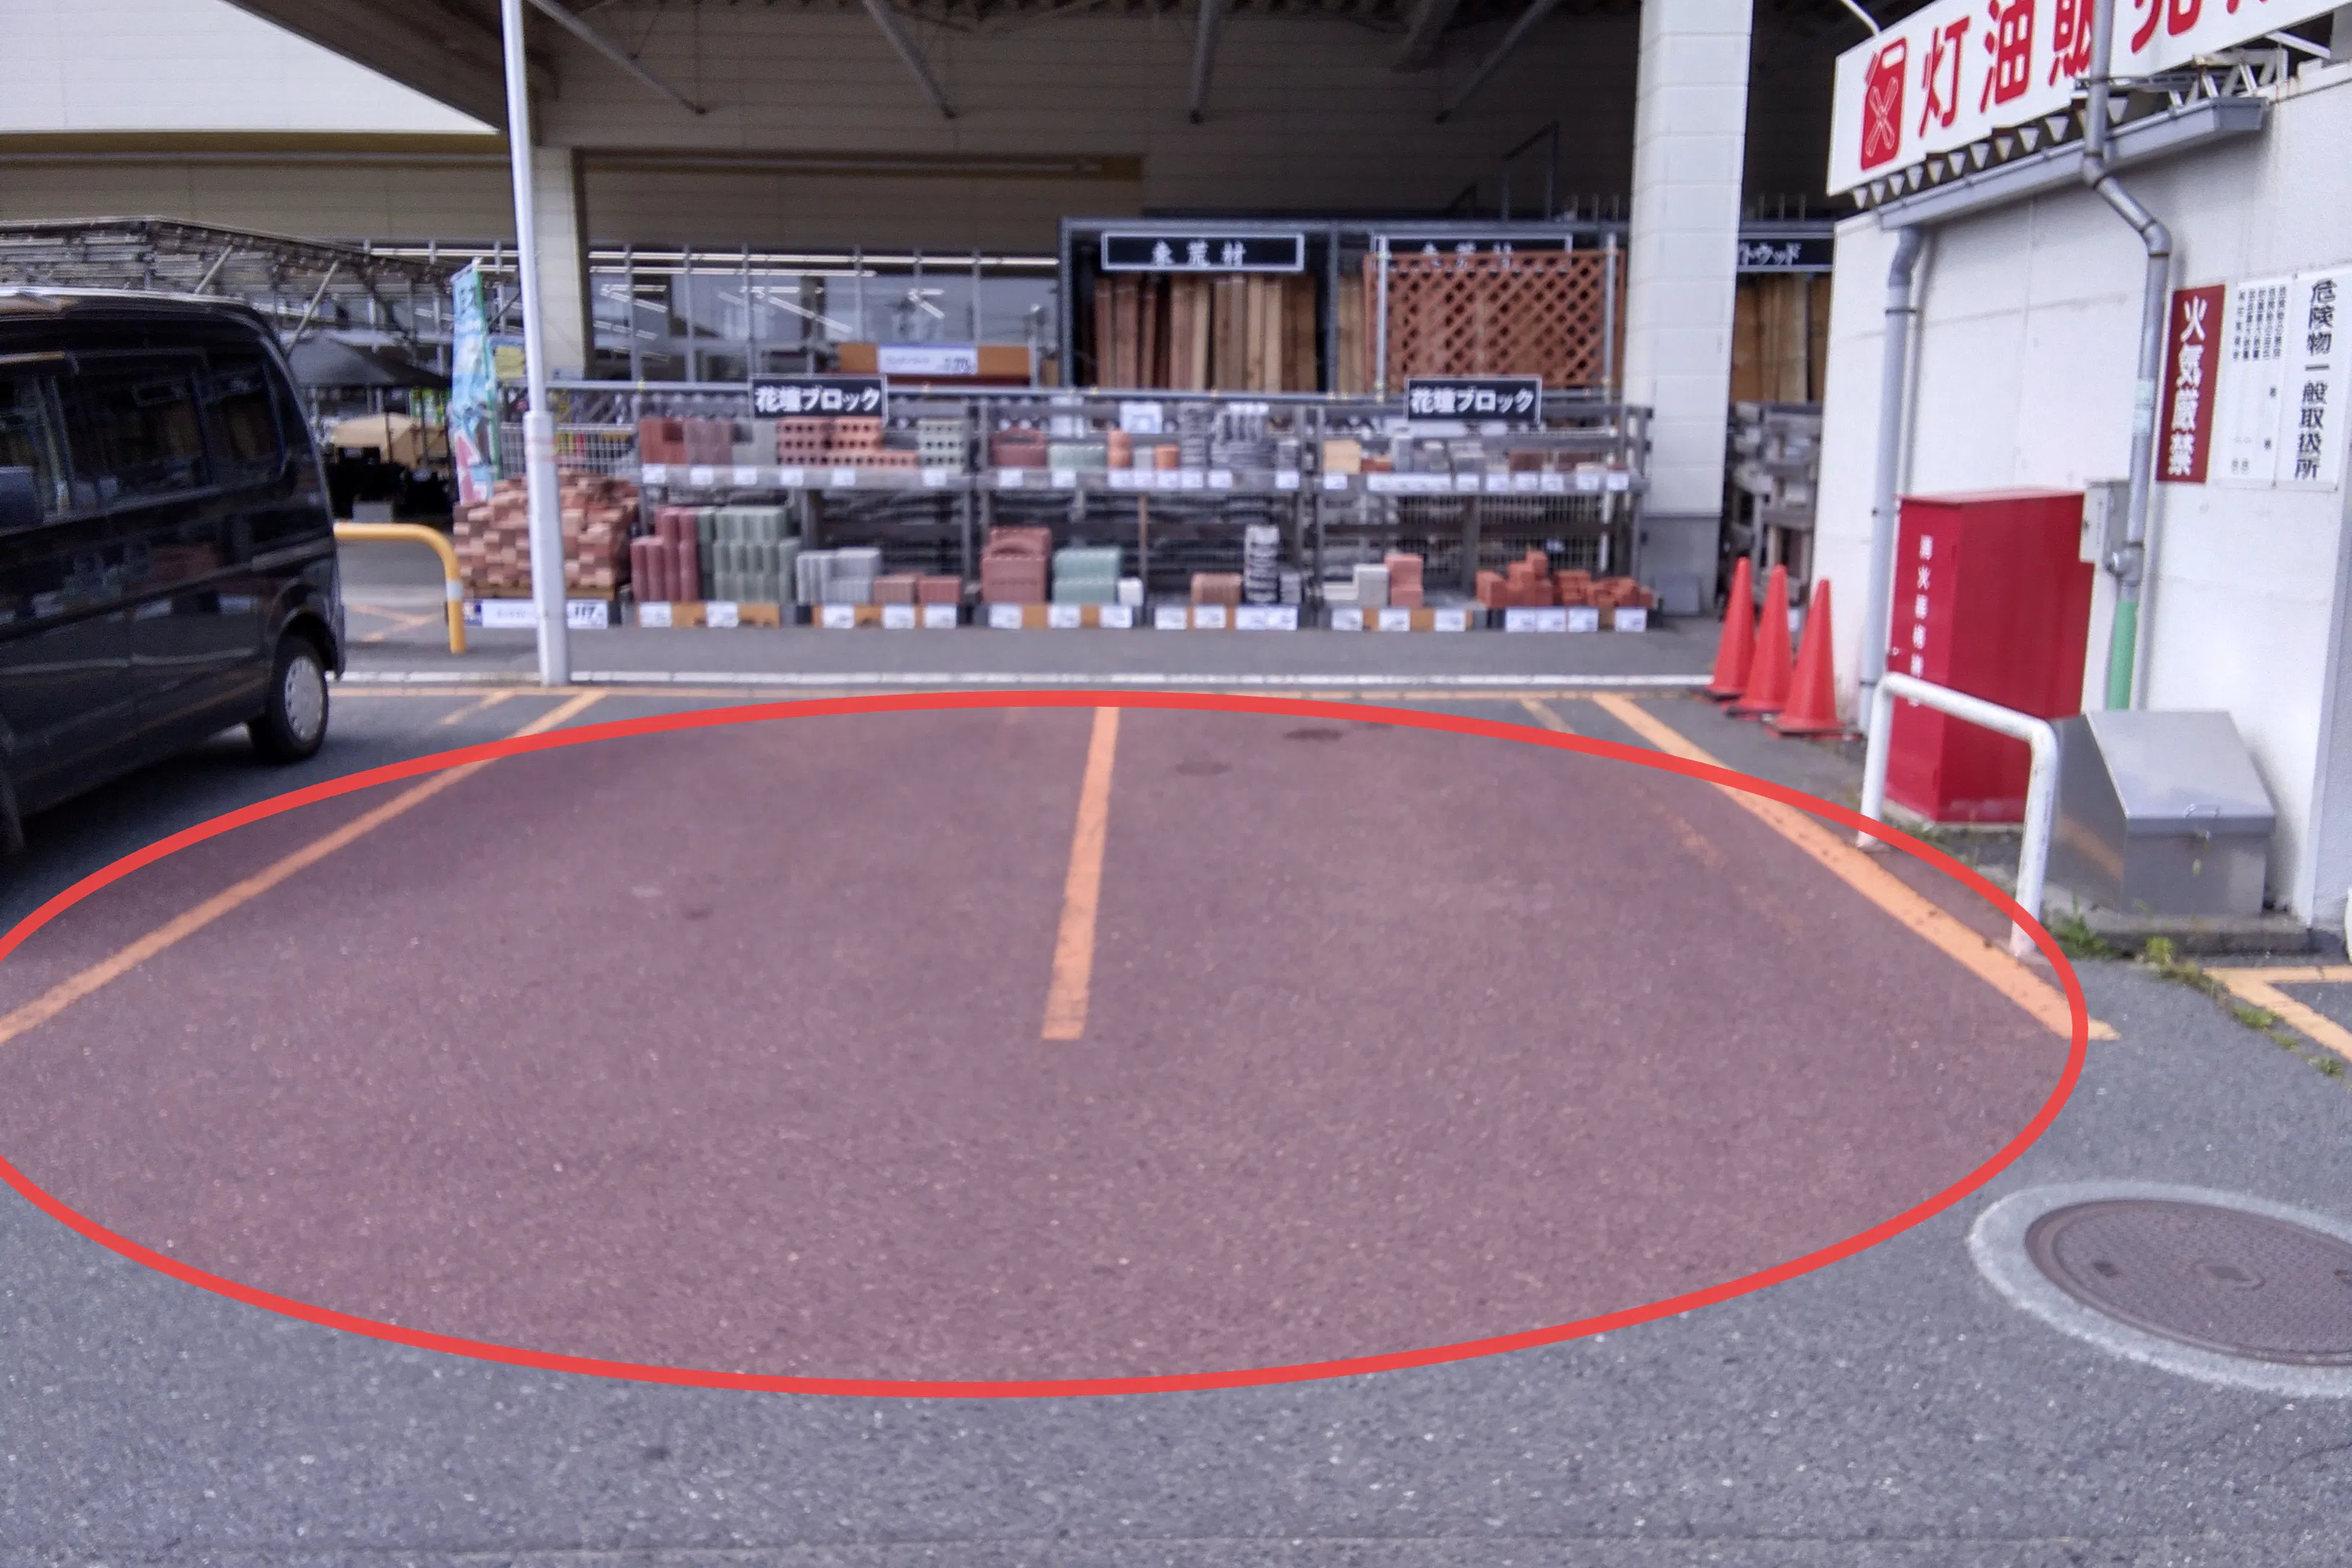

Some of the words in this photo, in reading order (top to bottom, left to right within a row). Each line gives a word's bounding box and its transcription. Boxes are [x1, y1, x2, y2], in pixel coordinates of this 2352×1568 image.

[754, 384, 881, 413] 花壇ブロック
[1409, 386, 1535, 414] 花壇ブロック
[2167, 295, 2208, 476] 火気厳禁
[2294, 277, 2338, 480] 危険物一般取扱所
